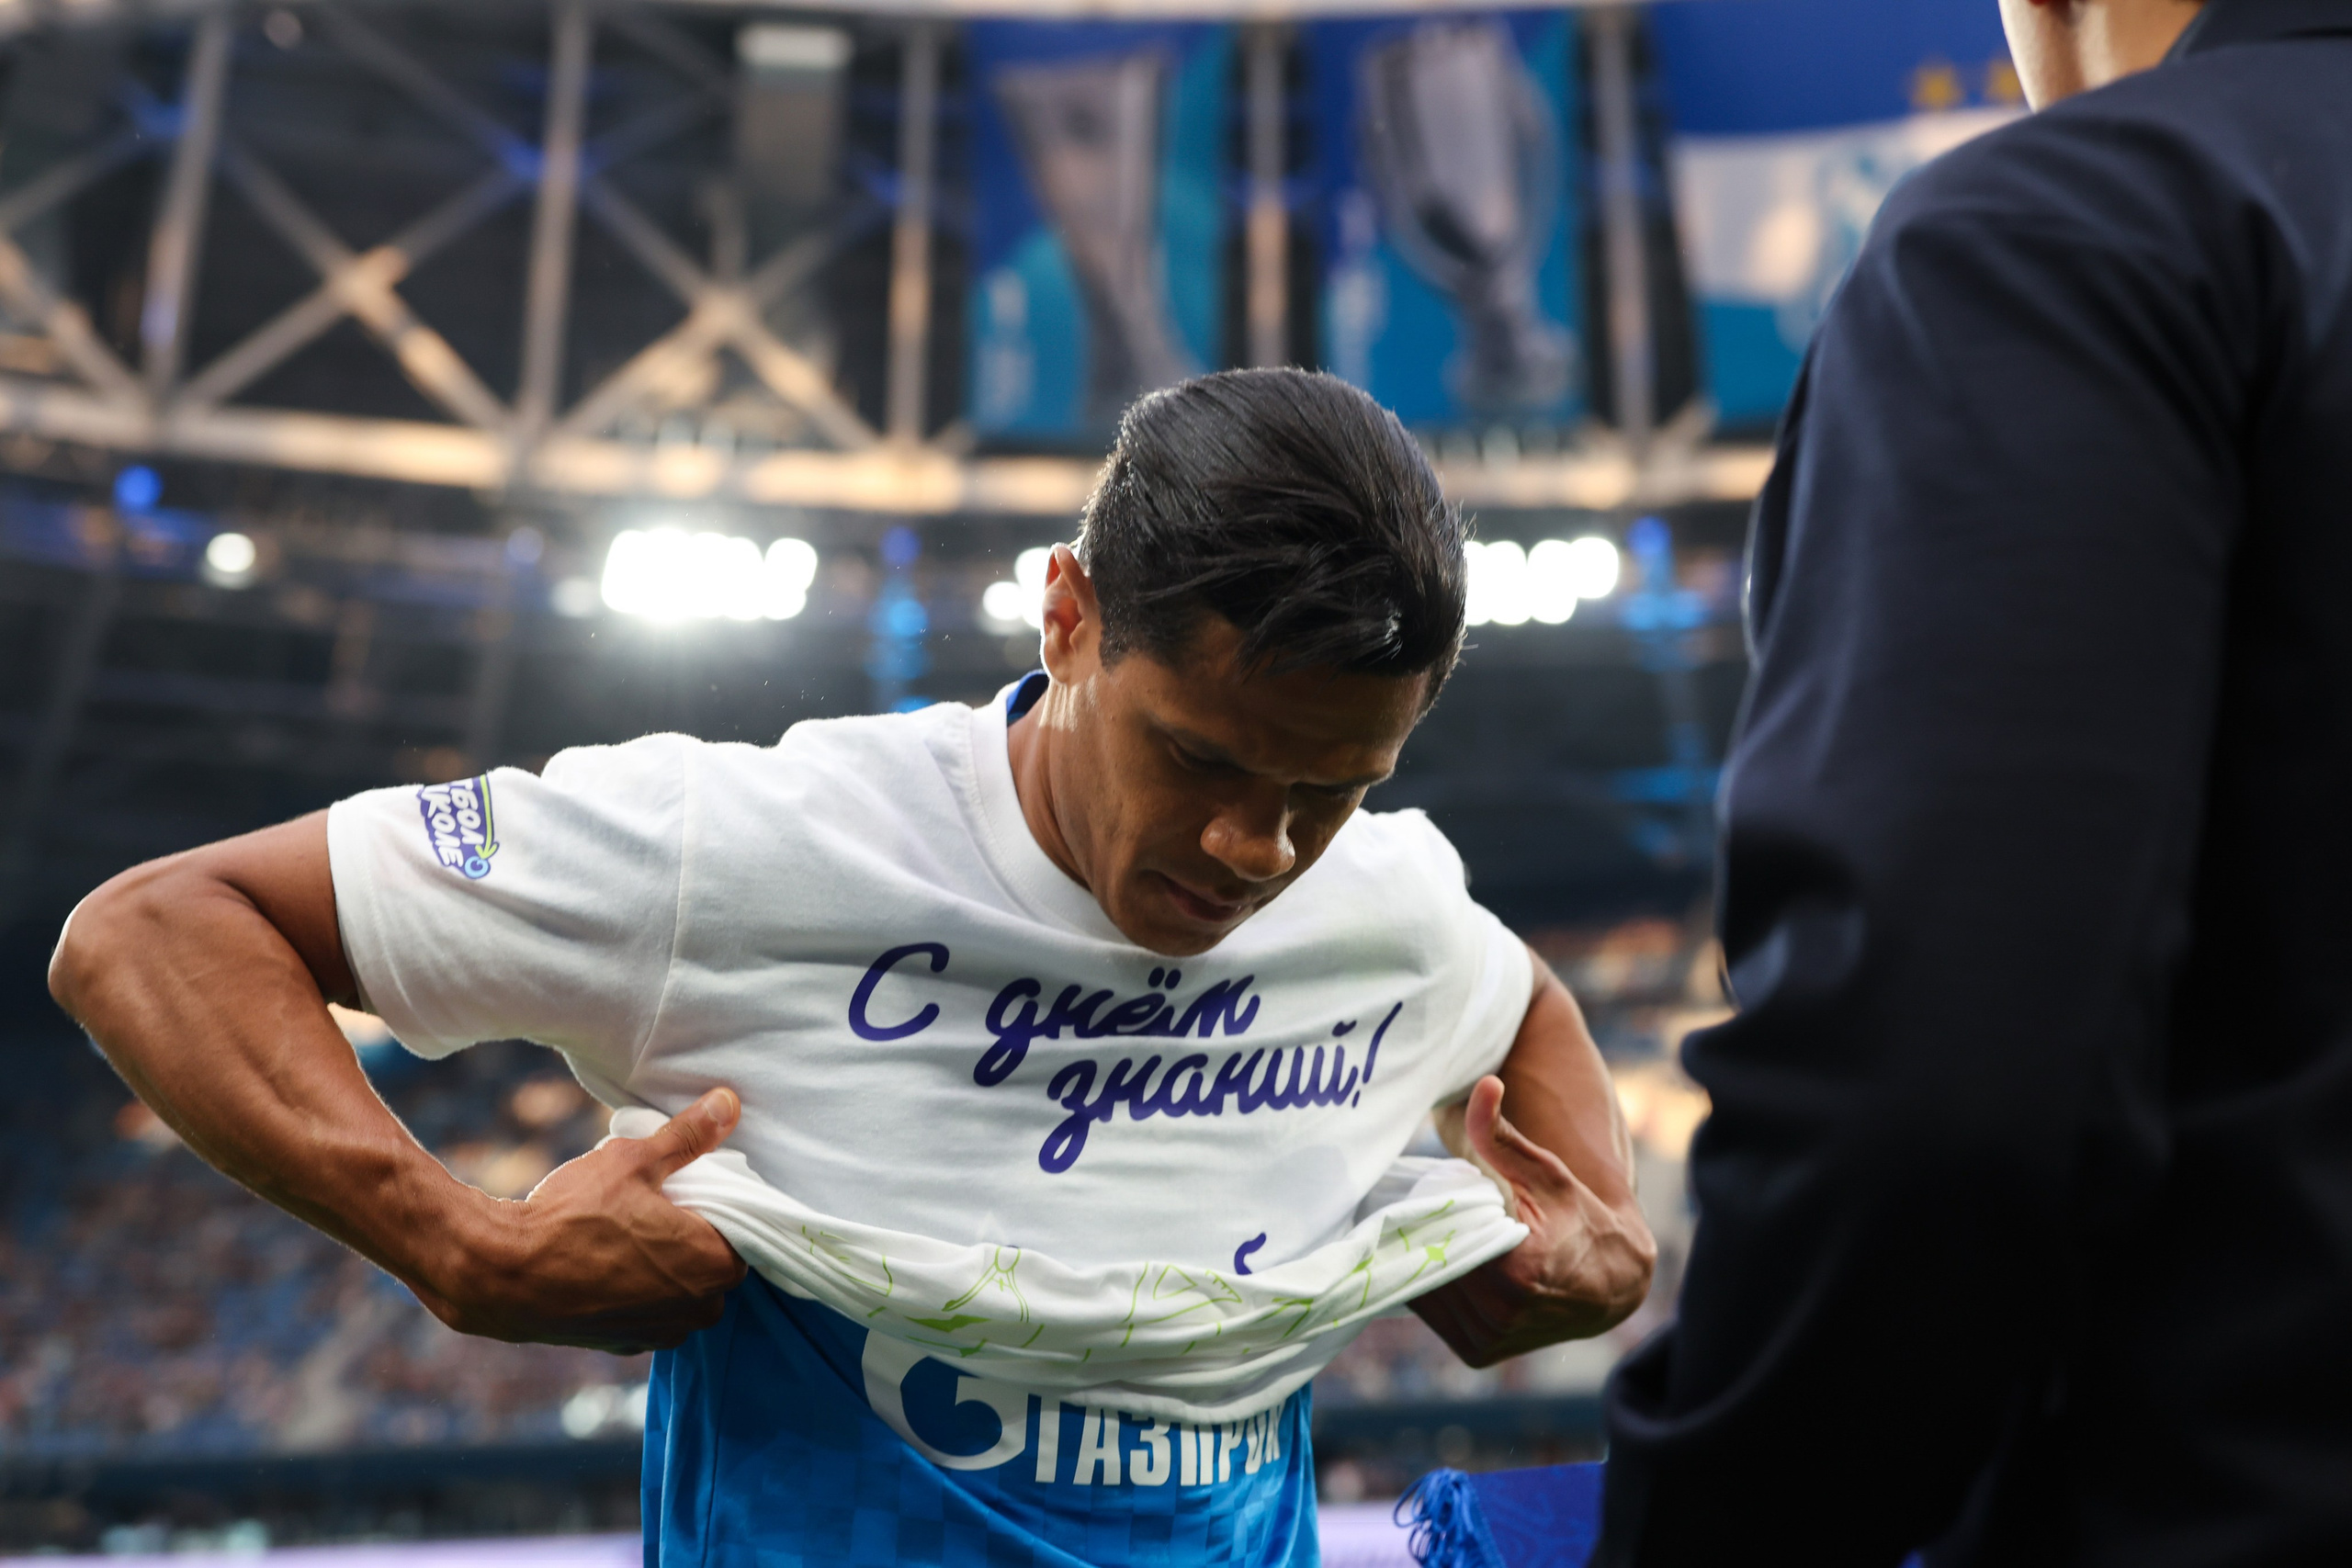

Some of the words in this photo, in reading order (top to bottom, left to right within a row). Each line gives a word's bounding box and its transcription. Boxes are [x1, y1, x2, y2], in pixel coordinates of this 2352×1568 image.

[848, 942, 950, 1041] С
[973, 966, 1261, 1087] днём
[1038, 1001, 1403, 1174] знаний!
